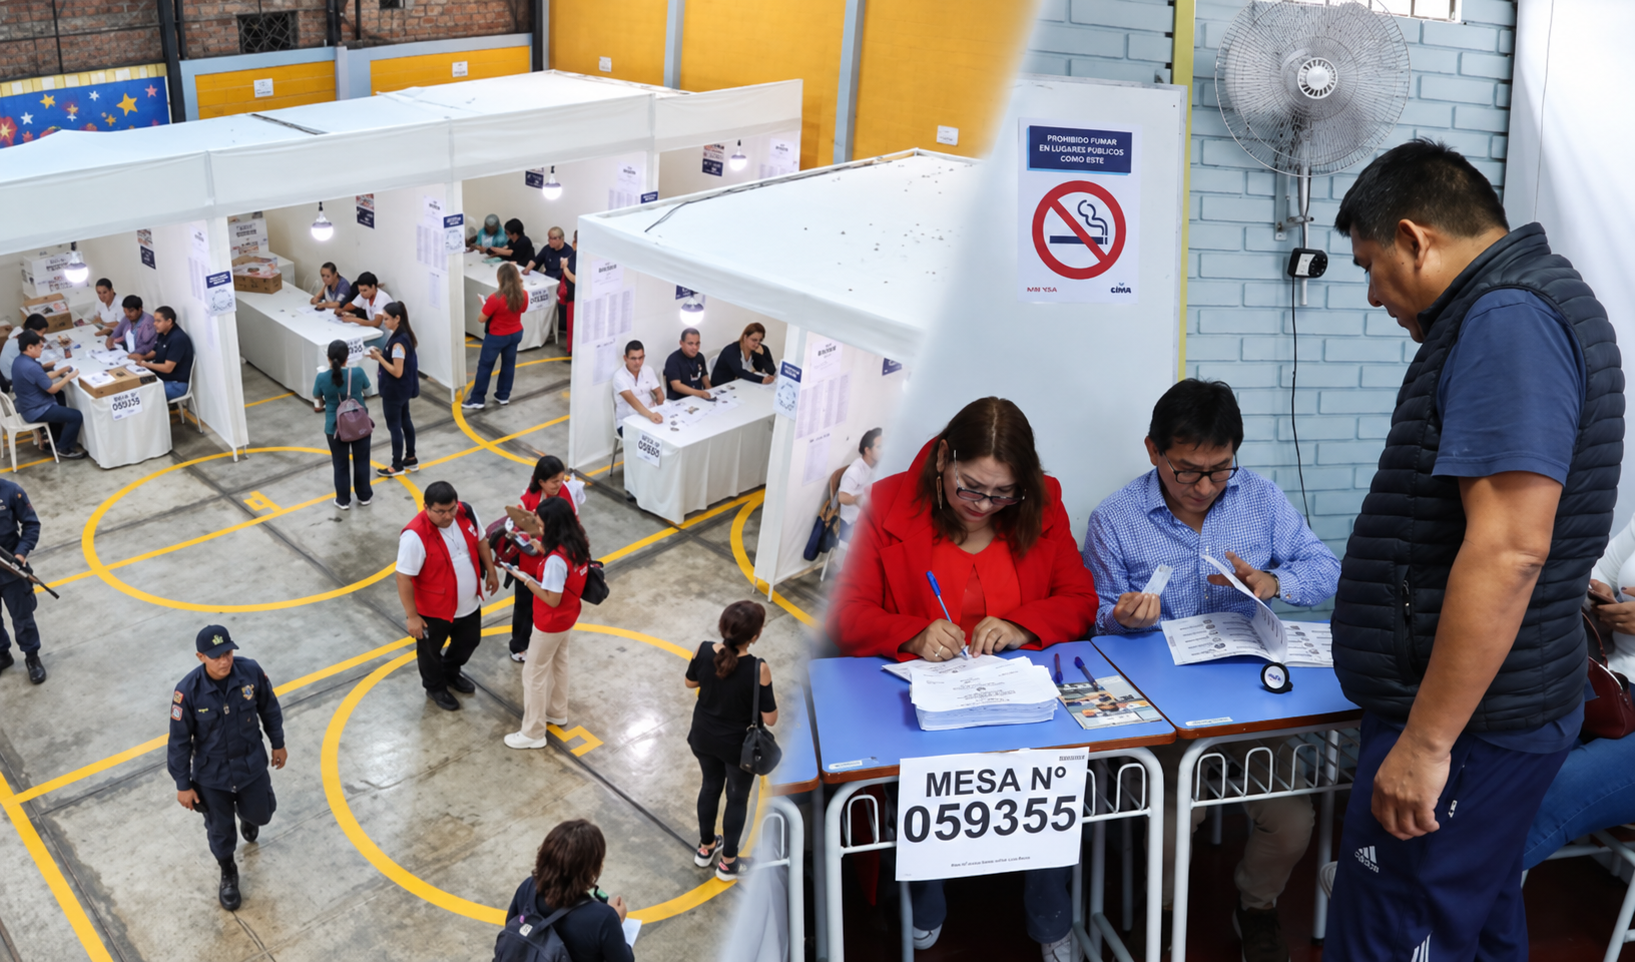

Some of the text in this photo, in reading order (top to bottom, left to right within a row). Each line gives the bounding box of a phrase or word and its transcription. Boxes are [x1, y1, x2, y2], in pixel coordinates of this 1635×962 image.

[1047, 134, 1117, 146] PROHIBIDO FUMAR
[1039, 144, 1050, 152] EN
[1051, 145, 1086, 153] LUGARES
[1060, 155, 1105, 164] COMO ESTE
[925, 768, 1021, 798] MESA
[903, 795, 1077, 843] 059355
